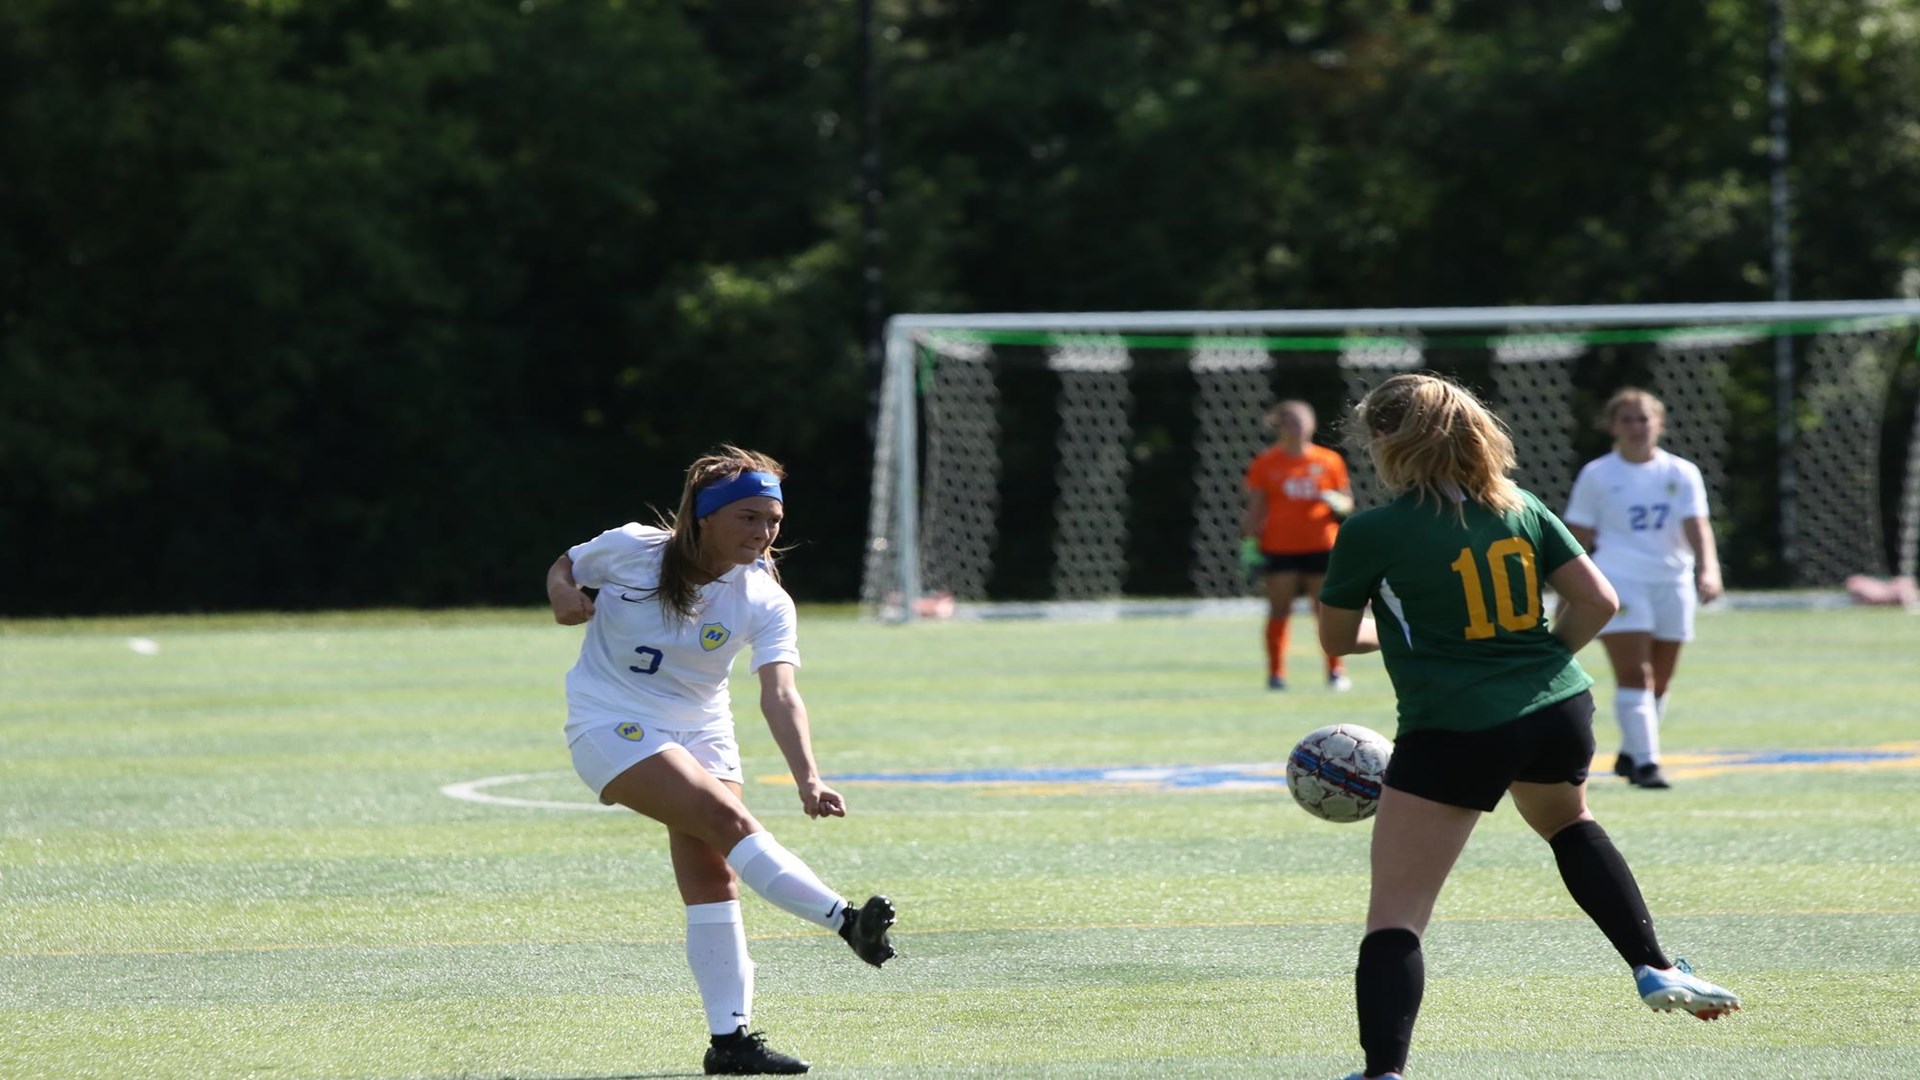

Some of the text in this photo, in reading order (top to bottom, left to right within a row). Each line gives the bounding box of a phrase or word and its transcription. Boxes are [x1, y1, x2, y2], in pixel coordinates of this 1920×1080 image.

[1629, 503, 1670, 530] 27
[1451, 537, 1539, 640] 10
[705, 630, 723, 641] M
[629, 645, 663, 675] 3
[623, 726, 637, 735] M
